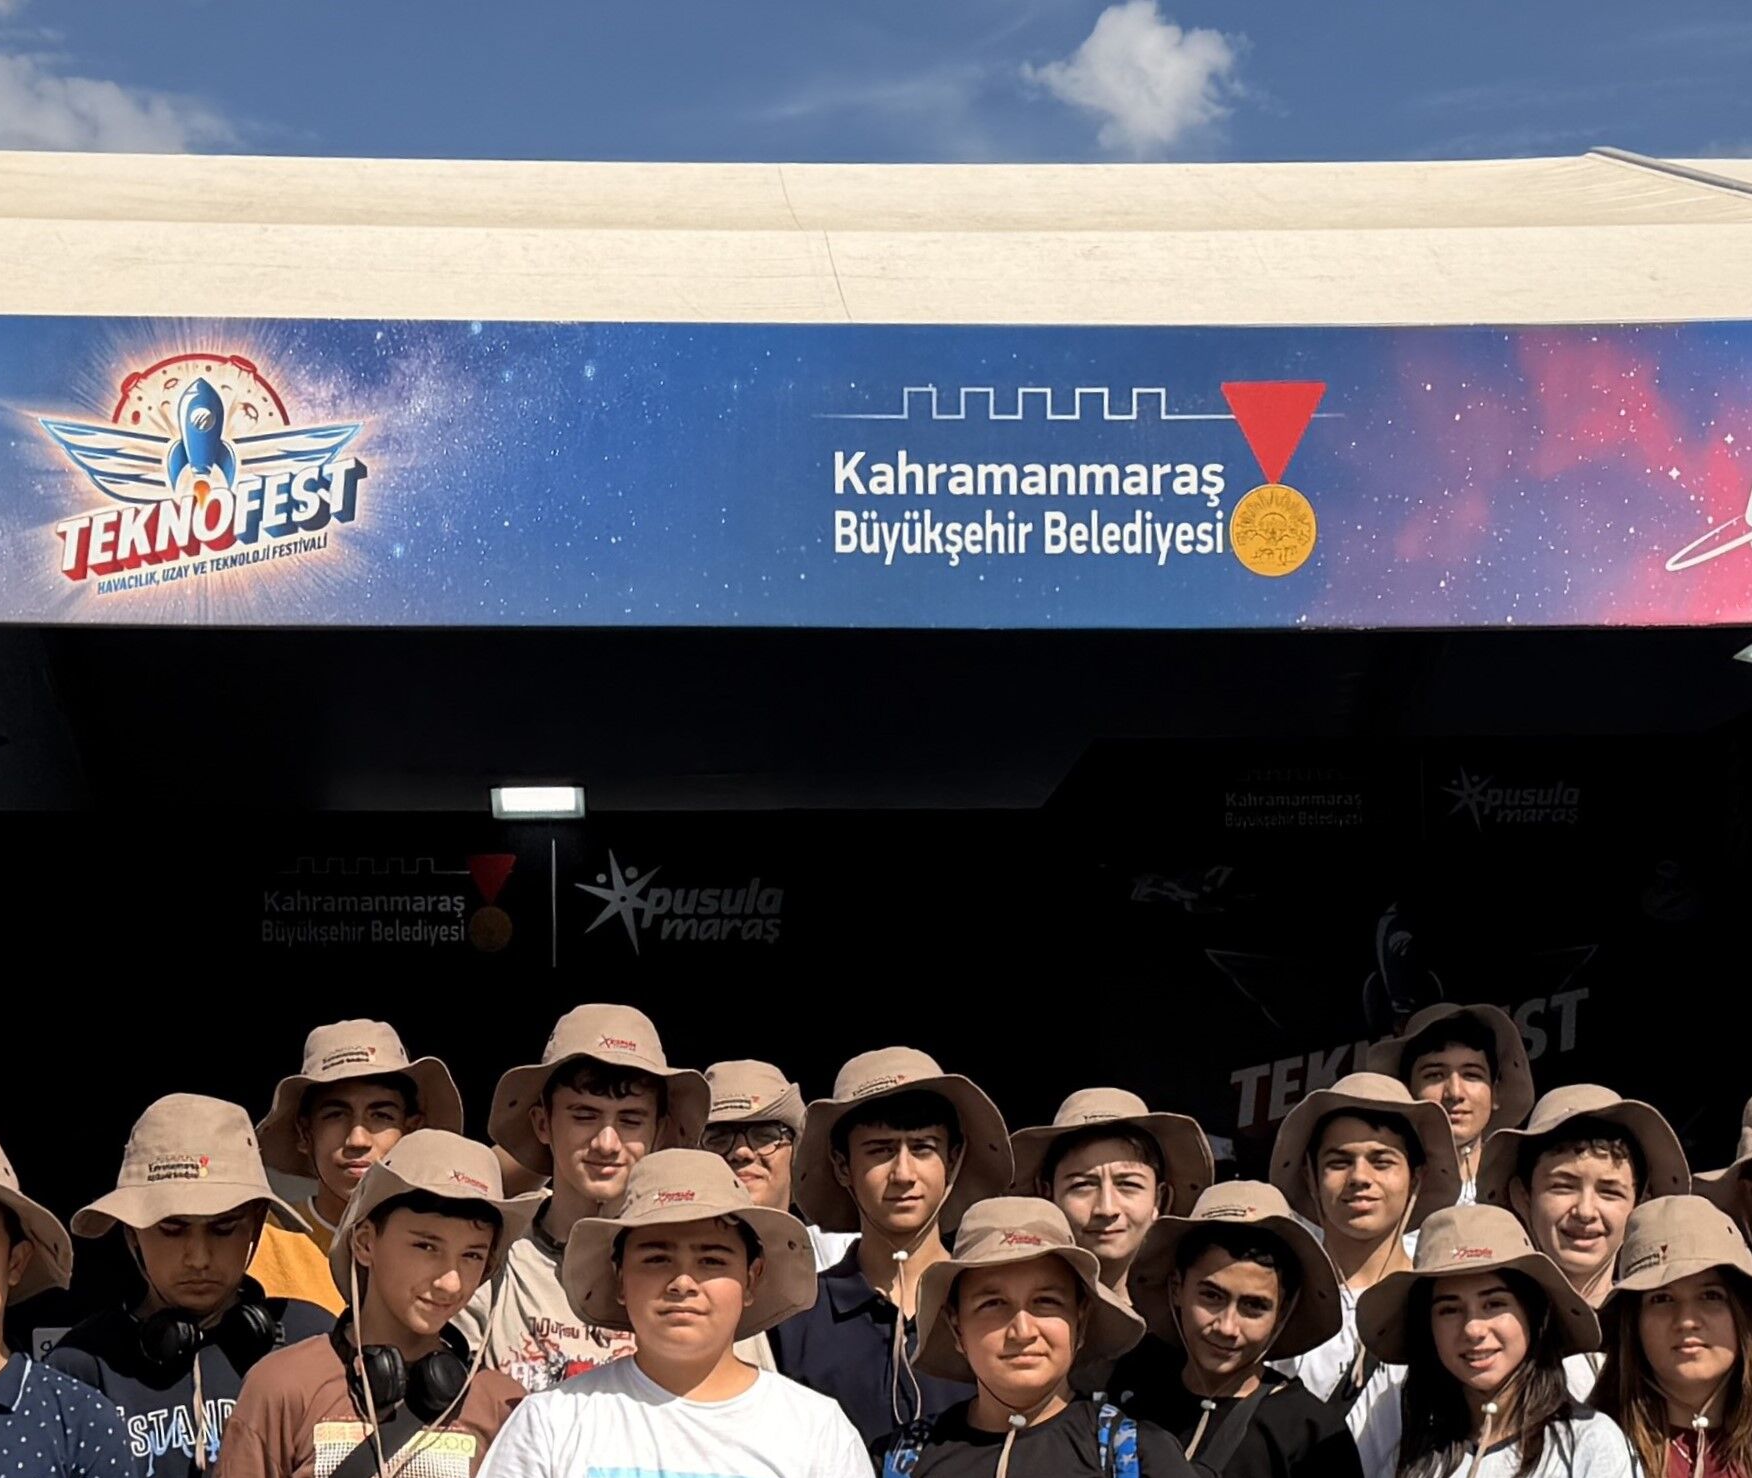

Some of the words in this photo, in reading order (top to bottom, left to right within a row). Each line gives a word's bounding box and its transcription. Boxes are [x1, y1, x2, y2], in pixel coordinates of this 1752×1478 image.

[834, 450, 1225, 508] Kahramanmaraş
[56, 457, 367, 581] TEKNOFEST
[834, 509, 1033, 567] Büyükşehir
[1044, 509, 1225, 567] Belediyesi
[161, 563, 190, 584] UZAY
[192, 561, 208, 575] VE
[209, 545, 270, 573] TEKNOLOJİ
[272, 532, 328, 559] FESTİVALİ
[263, 890, 466, 919] Kahramanmaraş
[642, 877, 784, 929] pusula
[660, 914, 783, 944] maraş
[261, 918, 366, 948] Büyükşehir
[370, 918, 466, 946] Belediyesi
